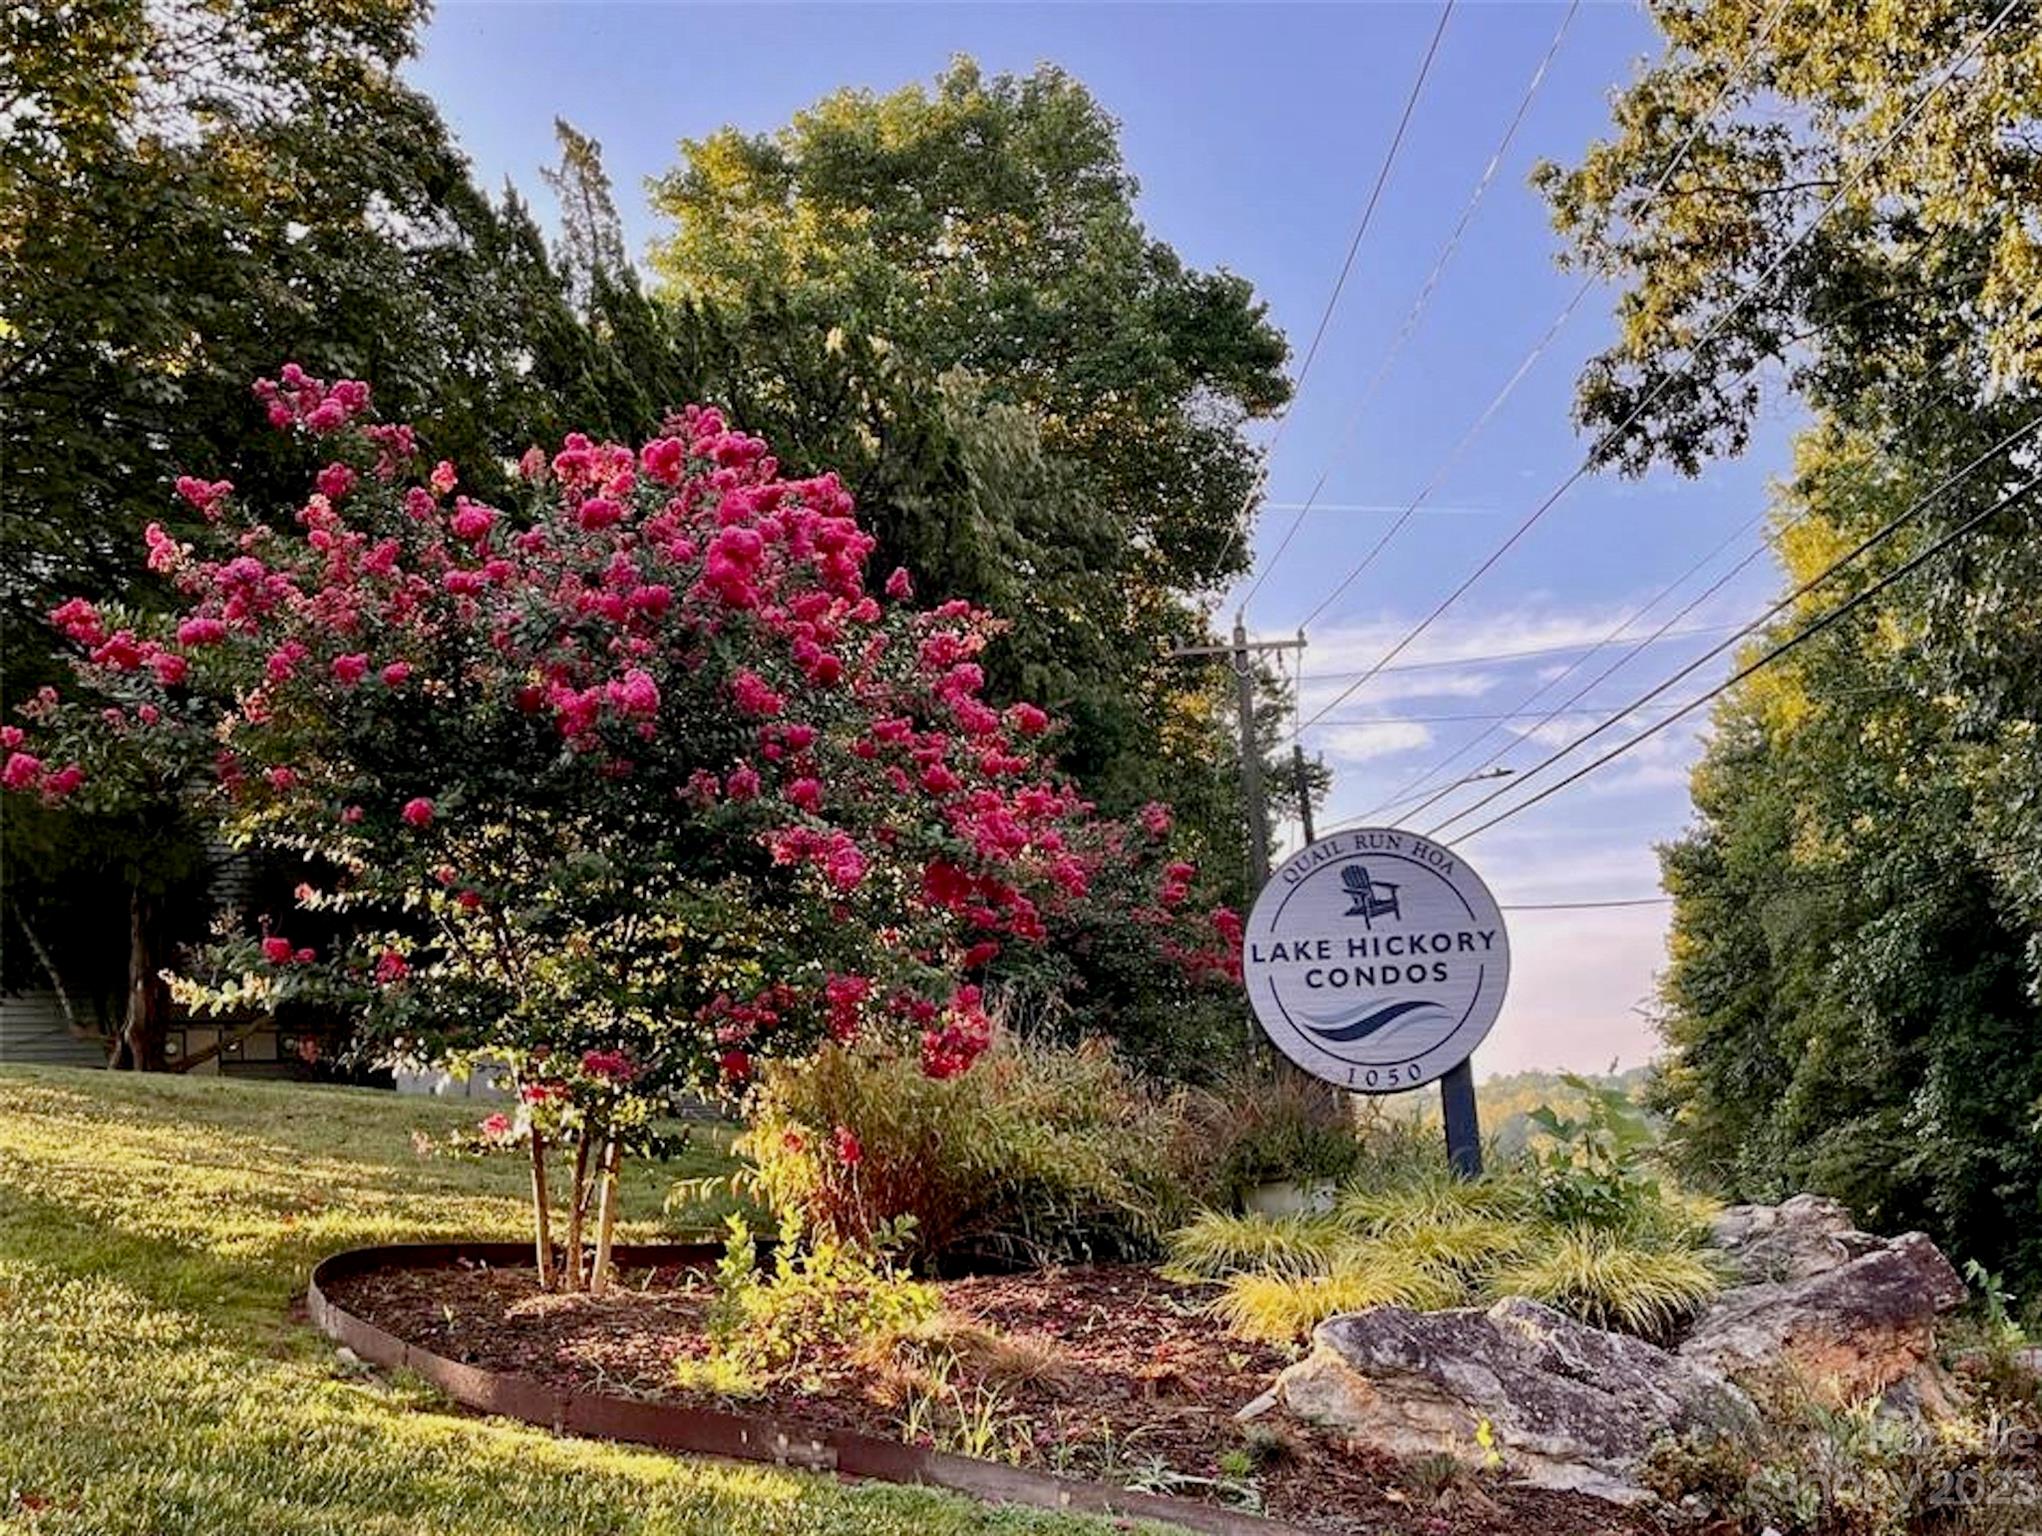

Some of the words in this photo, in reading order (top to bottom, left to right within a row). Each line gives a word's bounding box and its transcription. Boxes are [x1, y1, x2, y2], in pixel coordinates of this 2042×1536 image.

[1282, 840, 1344, 885] QUAIL
[1354, 833, 1403, 850] RUN
[1411, 841, 1454, 875] HOA
[1251, 940, 1331, 963] LAKE
[1347, 930, 1496, 958] HICKORY
[1305, 962, 1449, 989] CONDOS
[1348, 1062, 1422, 1087] 1050
